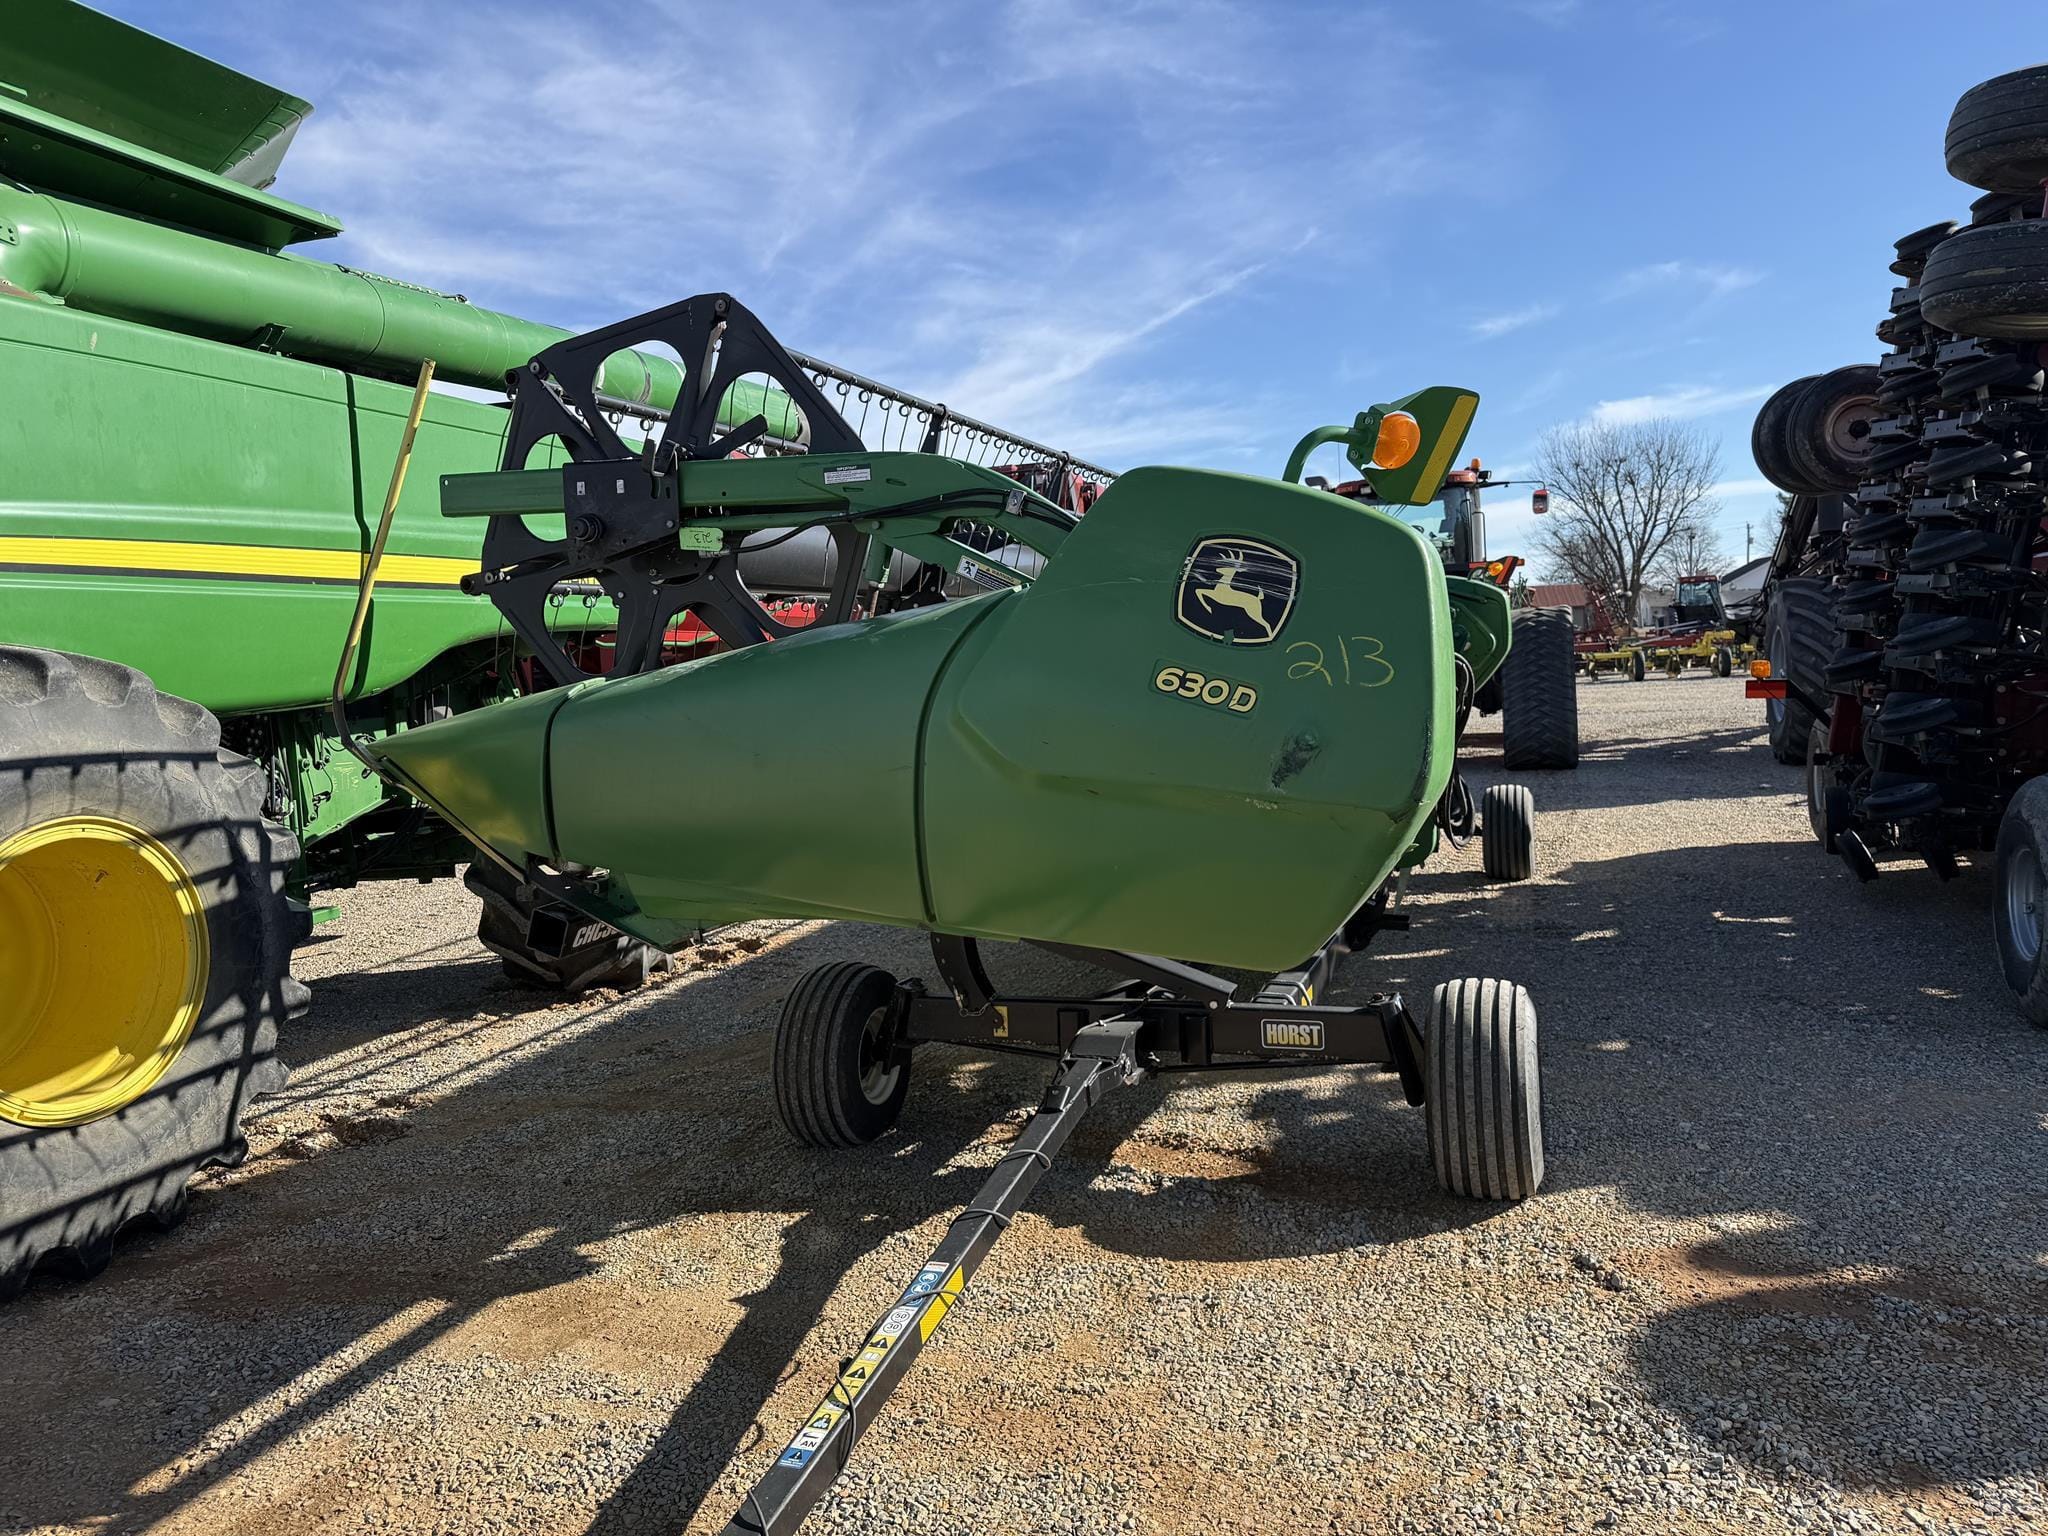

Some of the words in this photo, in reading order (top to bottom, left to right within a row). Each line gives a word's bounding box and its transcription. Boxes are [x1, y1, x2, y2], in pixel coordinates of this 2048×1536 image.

[694, 532, 713, 544] 213
[1285, 635, 1395, 688] 213
[1155, 666, 1257, 714] 630D
[1266, 1023, 1321, 1046] HORST
